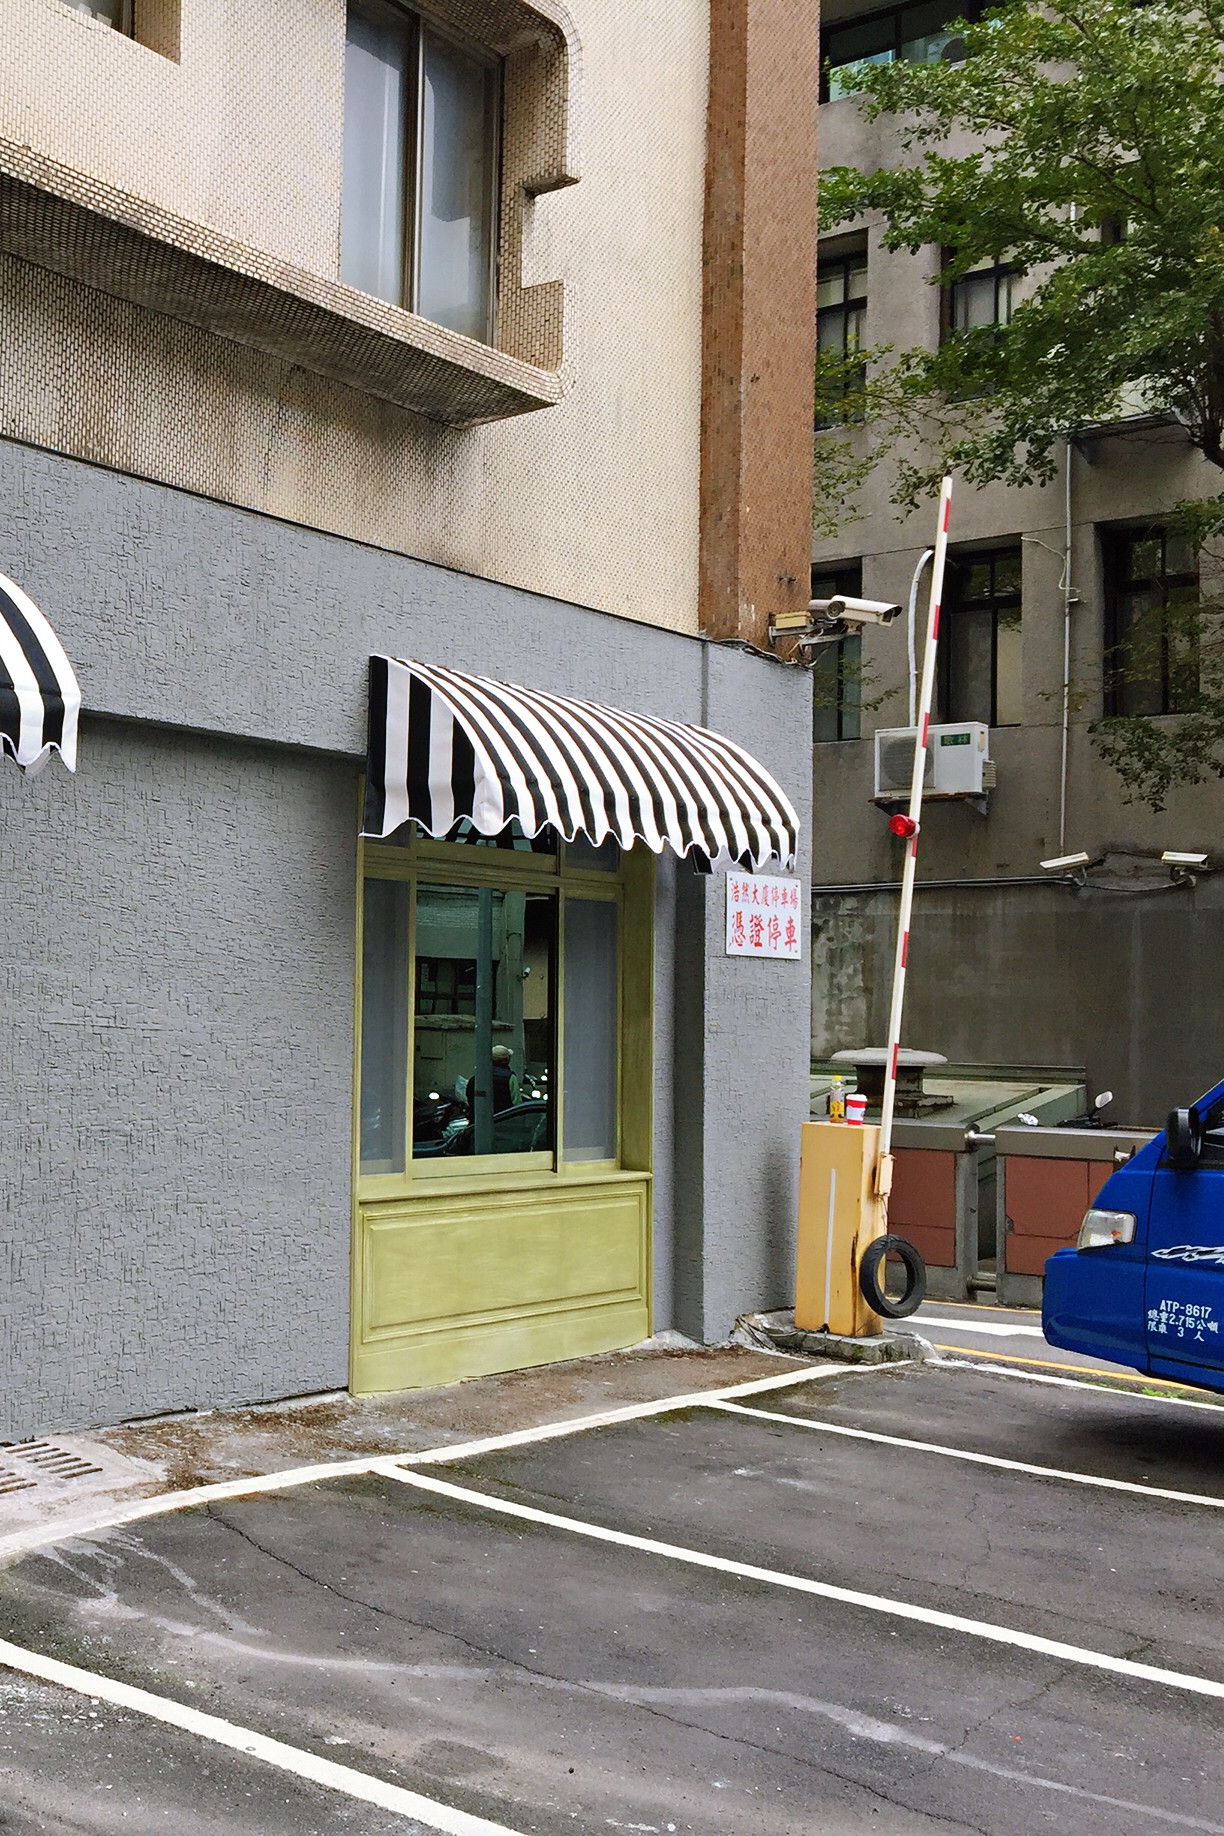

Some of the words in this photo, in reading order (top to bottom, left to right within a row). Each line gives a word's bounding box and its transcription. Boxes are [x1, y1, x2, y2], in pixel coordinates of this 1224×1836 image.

[732, 911, 797, 952] 憑證停車
[1159, 1299, 1211, 1318] ATP-8617
[1178, 1327, 1184, 1337] 3
[1194, 1331, 1205, 1341] 人
